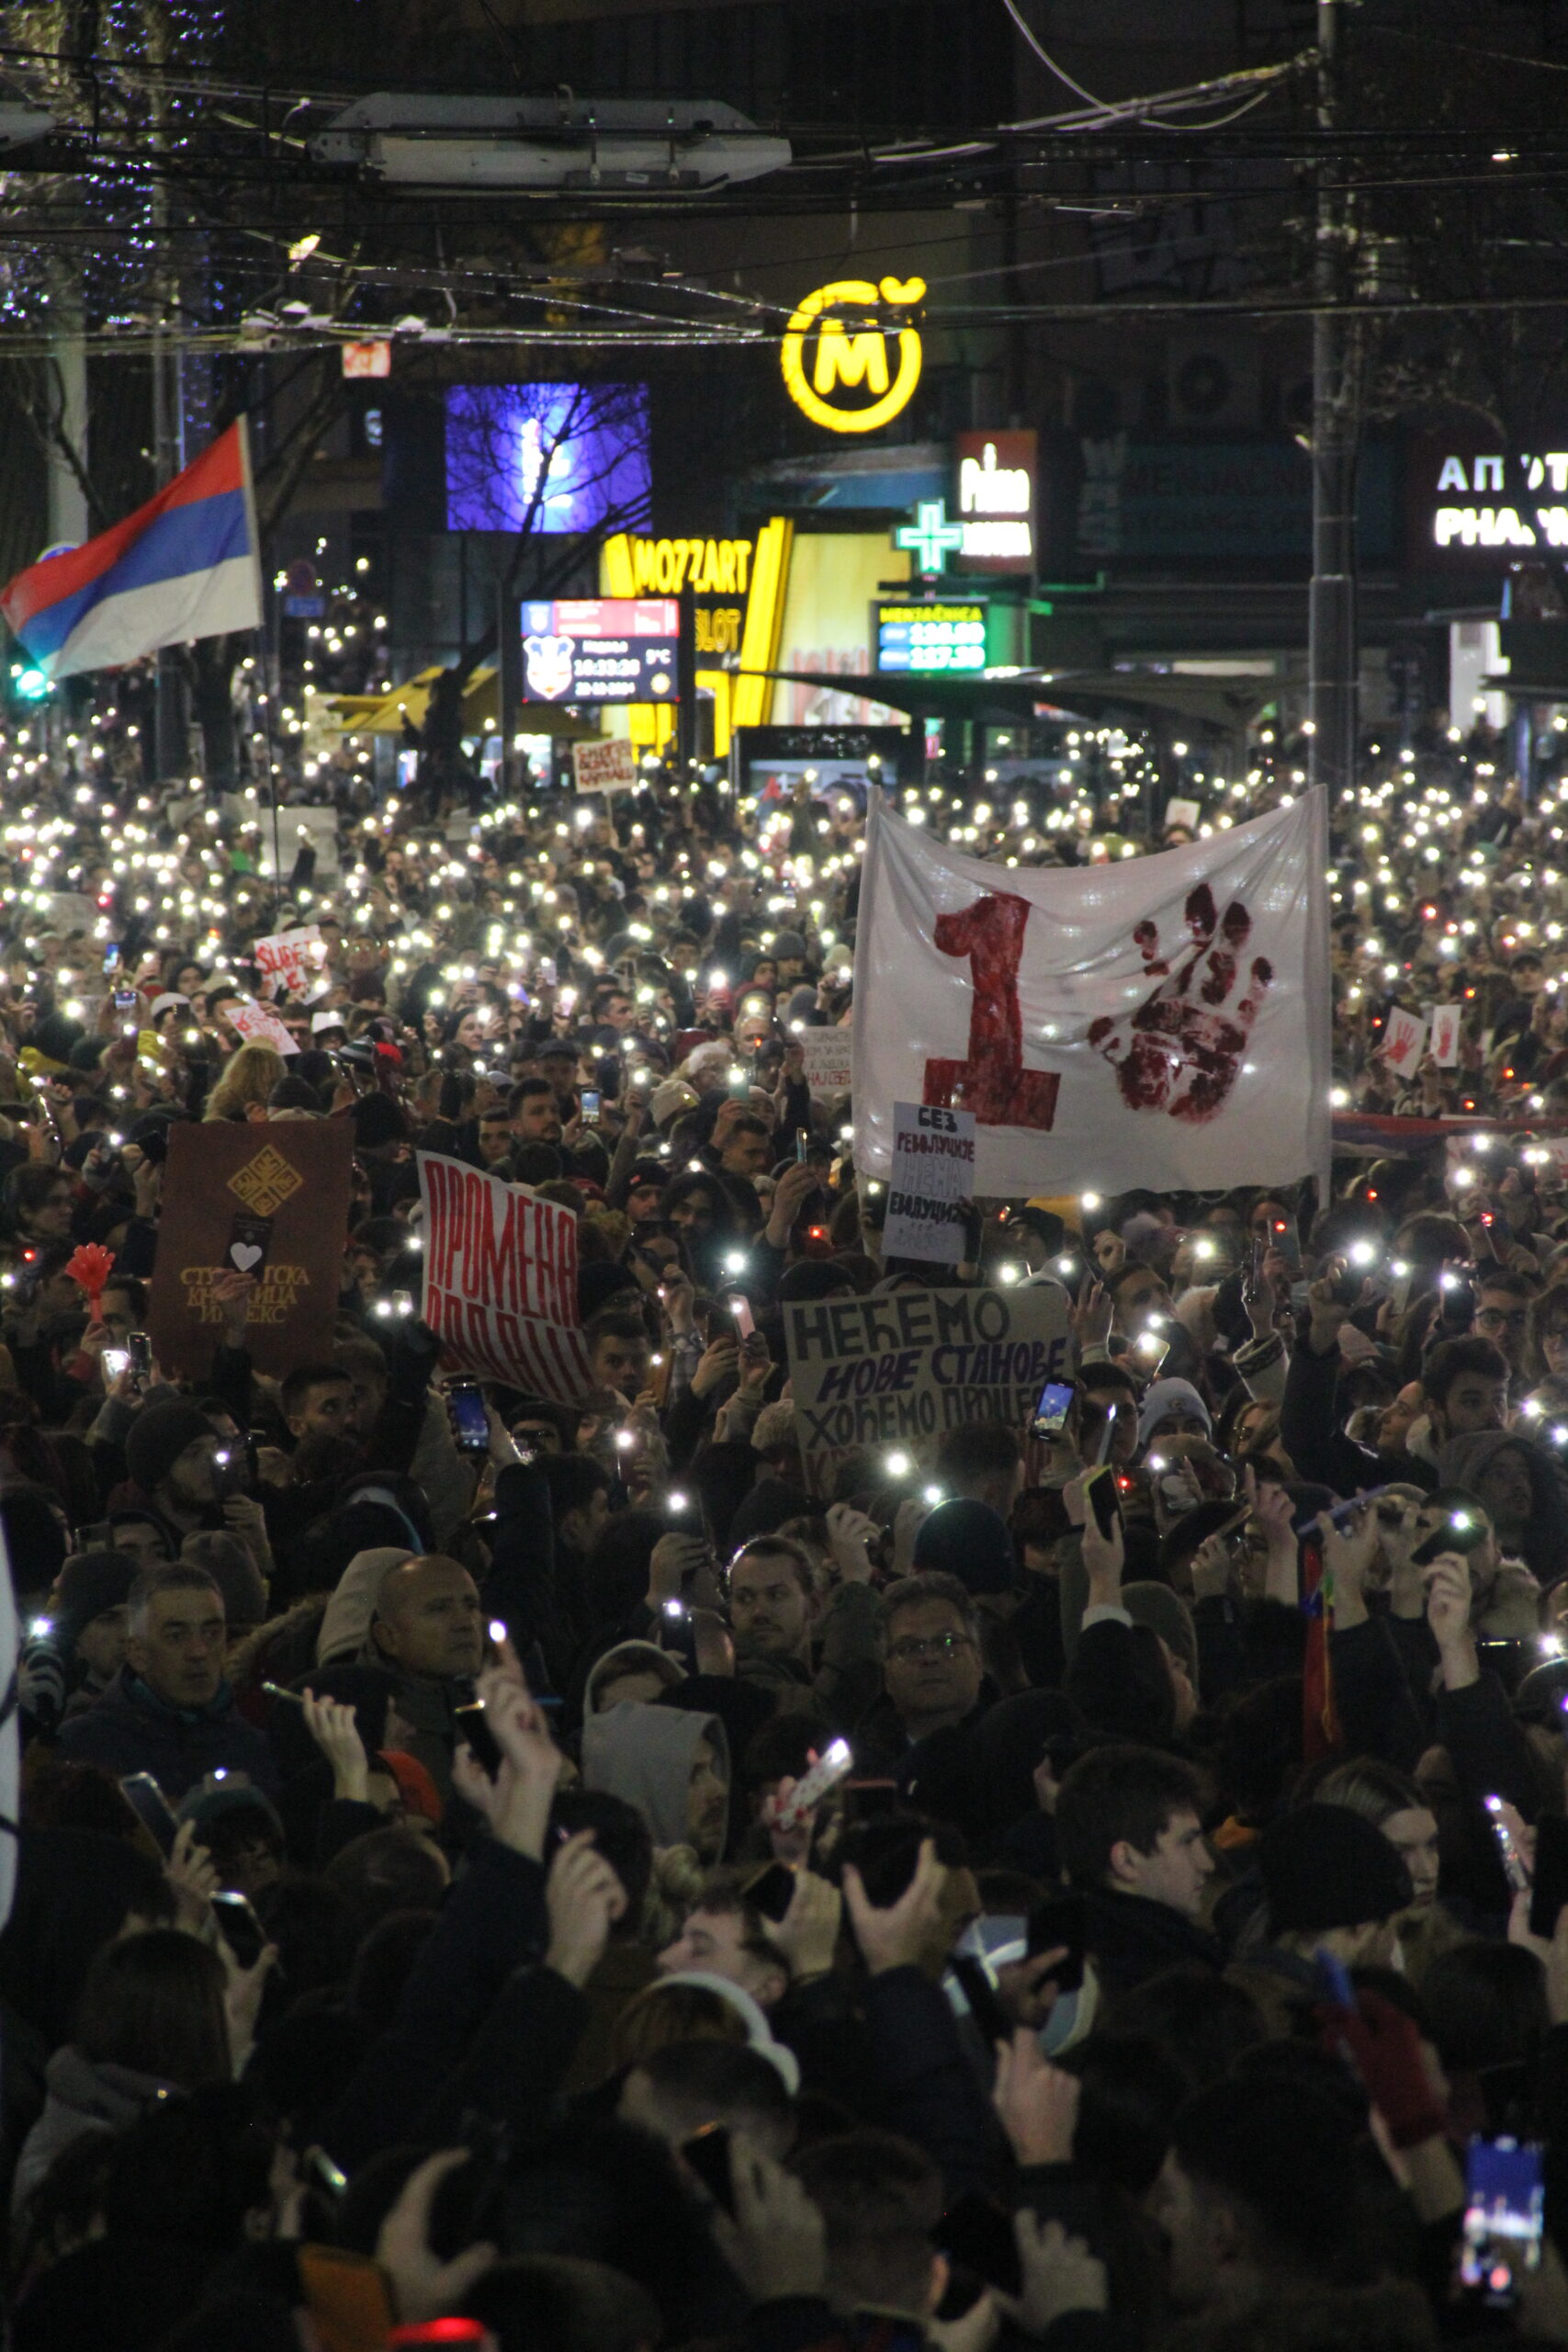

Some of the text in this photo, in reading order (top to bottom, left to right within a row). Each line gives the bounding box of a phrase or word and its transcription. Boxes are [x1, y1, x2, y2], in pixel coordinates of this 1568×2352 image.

[635, 537, 752, 594] MOZZART
[919, 1107, 957, 1133] БЕЗ
[424, 1159, 580, 1329] ПРОМЕНА
[792, 1290, 1009, 1362] НЕЋЕМО
[817, 1337, 1069, 1404] НОВЕ СТАНОВЕ
[802, 1388, 936, 1451] ХОЋЕМО
